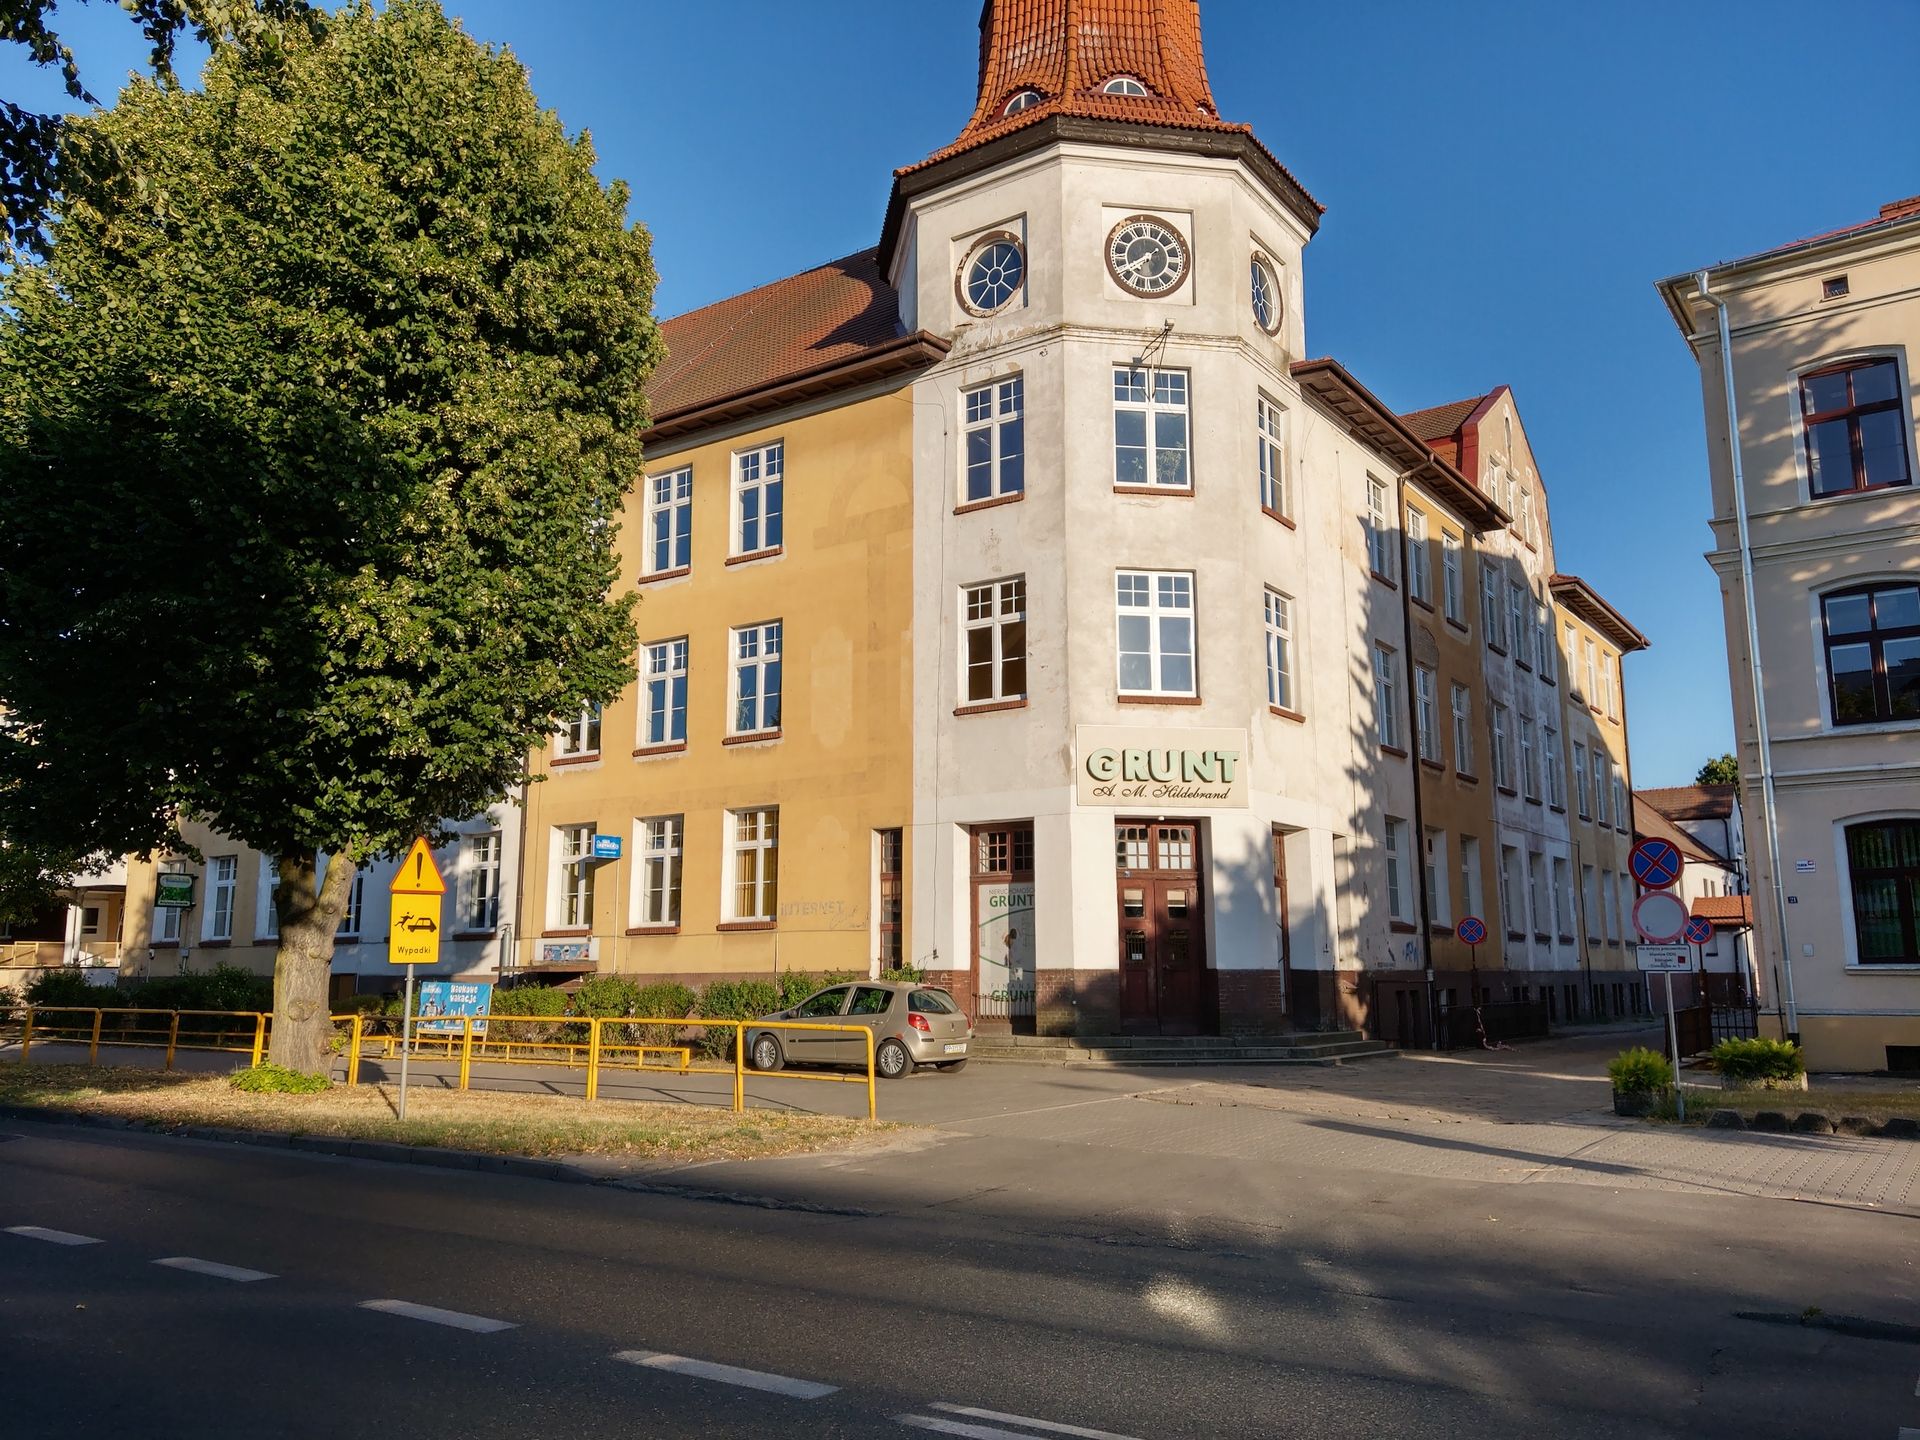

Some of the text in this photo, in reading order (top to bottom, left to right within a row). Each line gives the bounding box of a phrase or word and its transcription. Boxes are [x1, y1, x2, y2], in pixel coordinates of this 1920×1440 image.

[1086, 748, 1240, 783] GRUNT
[1093, 783, 1231, 800] A. M. Hildebrand
[990, 894, 1035, 907] GRUNT
[397, 945, 431, 956] Wypadki
[992, 990, 1036, 1002] GRUNT
